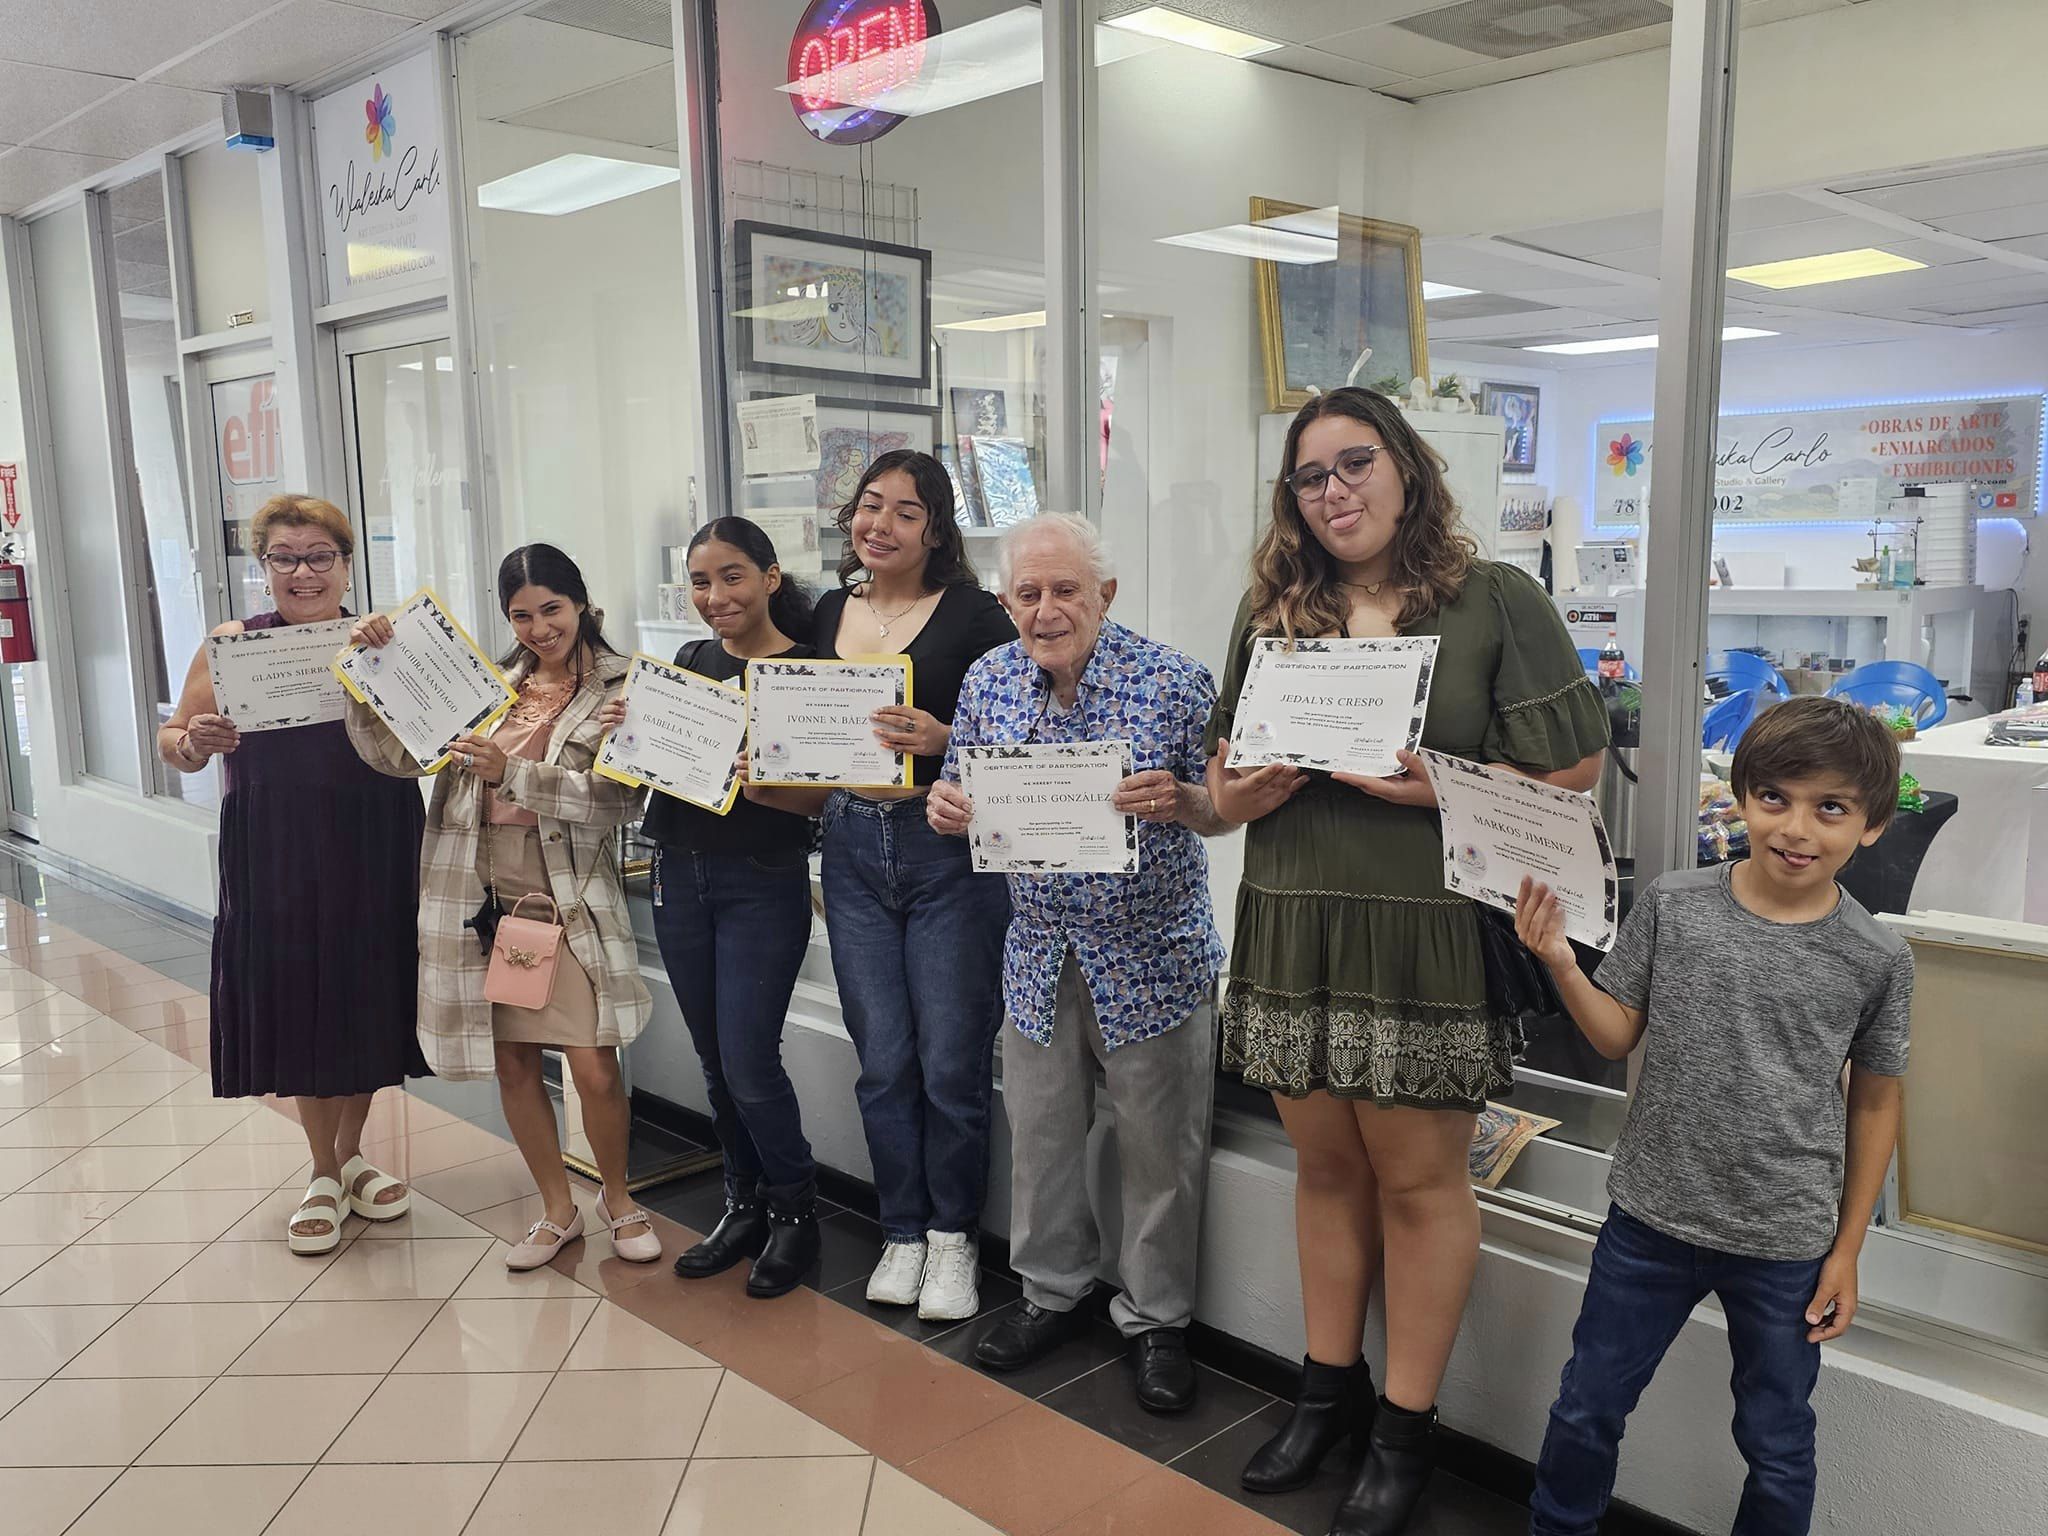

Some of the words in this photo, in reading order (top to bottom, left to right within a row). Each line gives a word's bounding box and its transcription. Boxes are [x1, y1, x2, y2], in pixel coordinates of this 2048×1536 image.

[798, 0, 923, 109] OPEN
[1868, 418, 1923, 435] OBRAS
[1930, 416, 1951, 431] DE
[1957, 412, 2001, 431] ARTE
[1879, 436, 1995, 456] ENMARCADOS
[1892, 458, 2015, 478] EXHIBICIONES
[1716, 478, 1743, 487] Studio
[1755, 476, 1786, 488] Gallery
[251, 670, 293, 682] GLADYS
[295, 666, 331, 677] SIERRA
[424, 674, 458, 713] SANTIAGO
[1280, 694, 1334, 705] JEDALYS
[1337, 697, 1384, 707] CRESPO
[787, 715, 827, 723] IVONNE
[642, 713, 682, 735] ISABELLA
[697, 734, 722, 750] CRUZ
[986, 794, 1012, 805] JOSÉ
[1050, 792, 1112, 802] GONZÁLEZ
[1472, 814, 1521, 838] MARKOS
[1524, 831, 1575, 856] JIMENEZ
